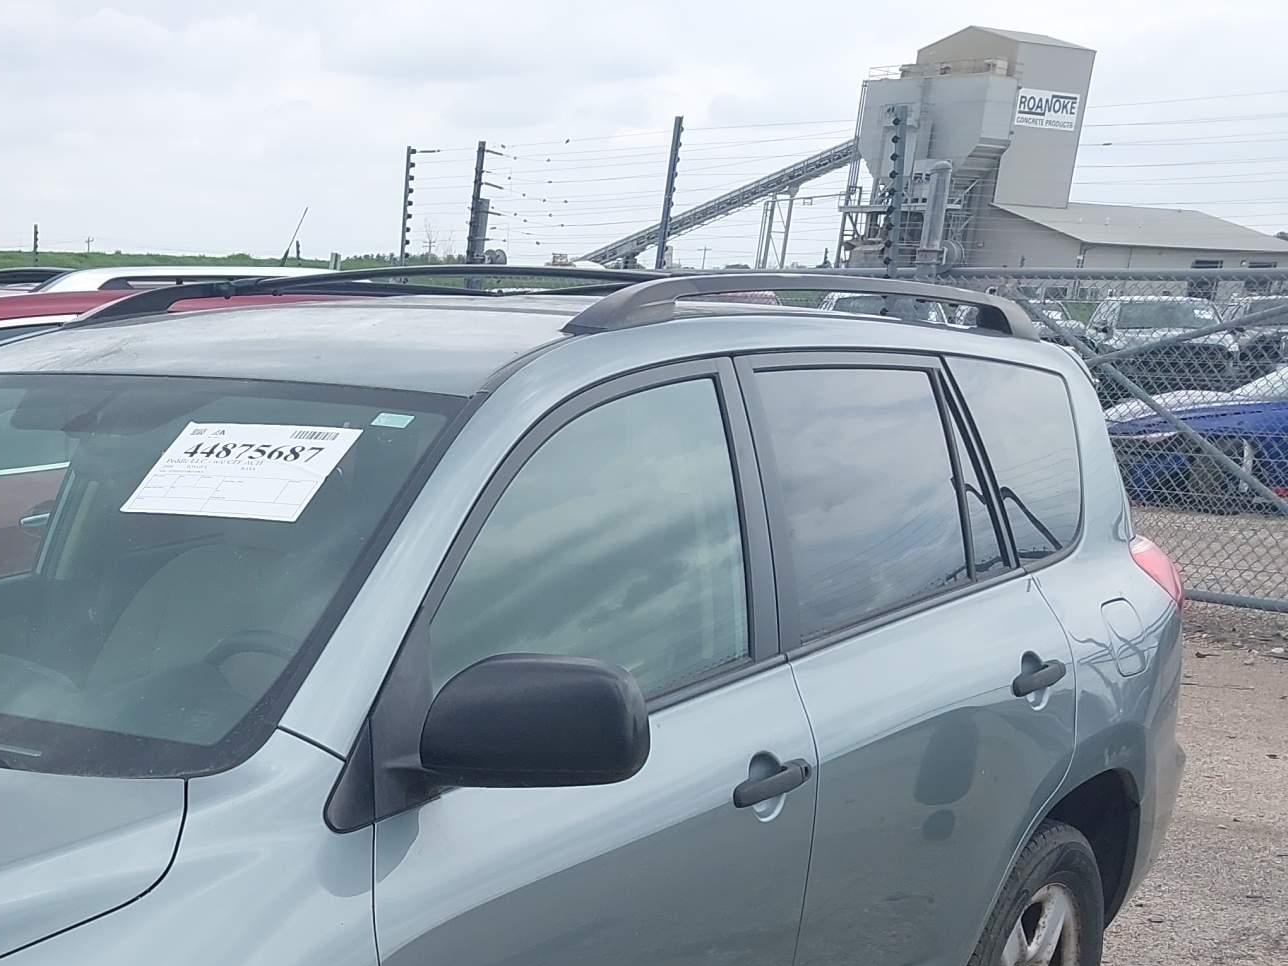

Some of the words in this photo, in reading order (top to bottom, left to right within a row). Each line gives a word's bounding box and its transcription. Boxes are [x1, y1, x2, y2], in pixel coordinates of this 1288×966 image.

[1018, 95, 1077, 115] ROANOKE
[1016, 116, 1045, 126] CONCRETE
[1045, 119, 1073, 129] PRODUCTS
[184, 442, 324, 463] 44875687
